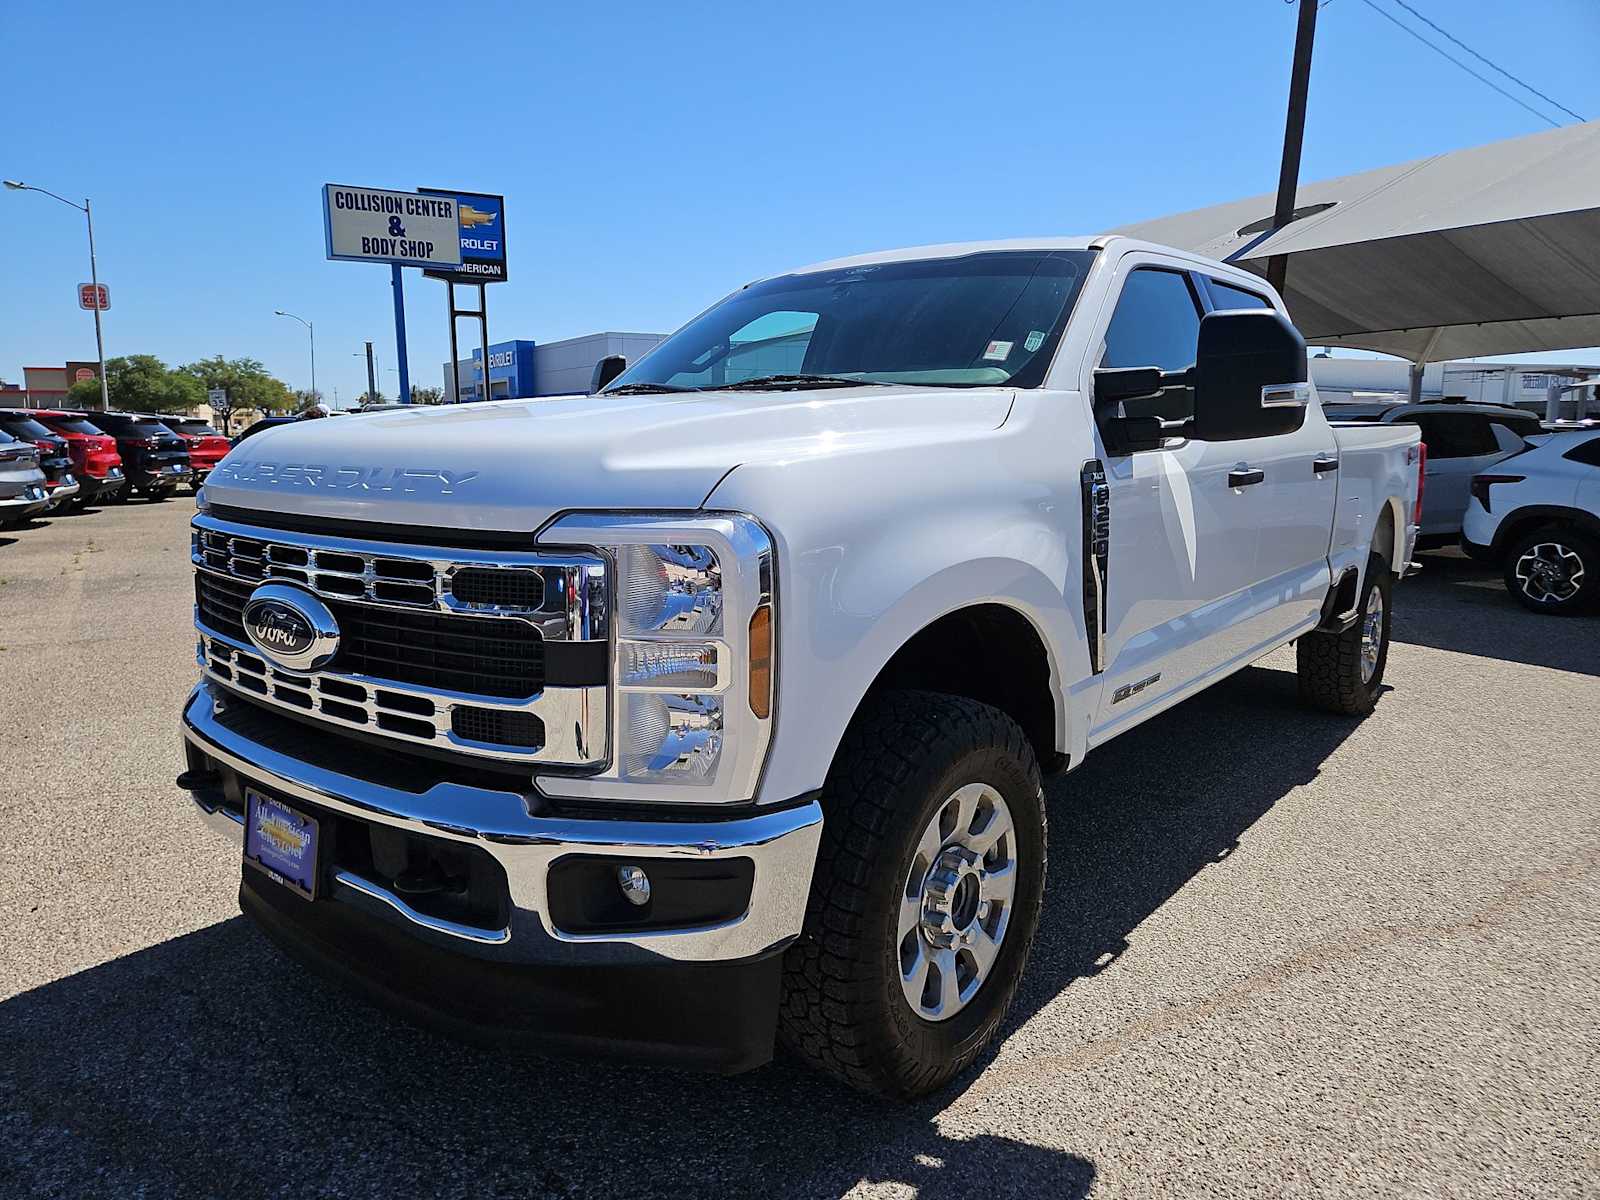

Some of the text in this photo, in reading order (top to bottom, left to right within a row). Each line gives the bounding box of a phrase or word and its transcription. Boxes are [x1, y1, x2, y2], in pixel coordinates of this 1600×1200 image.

[335, 191, 453, 219] COLLISION CENTER
[388, 215, 406, 238] &
[361, 236, 434, 259] BODY SHOP
[461, 238, 499, 251] ROLET
[490, 351, 513, 368] EVROLET
[212, 399, 225, 407] 35
[220, 461, 480, 495] SUPER DUTY
[1092, 472, 1105, 480] XLT
[255, 608, 299, 648] Ford
